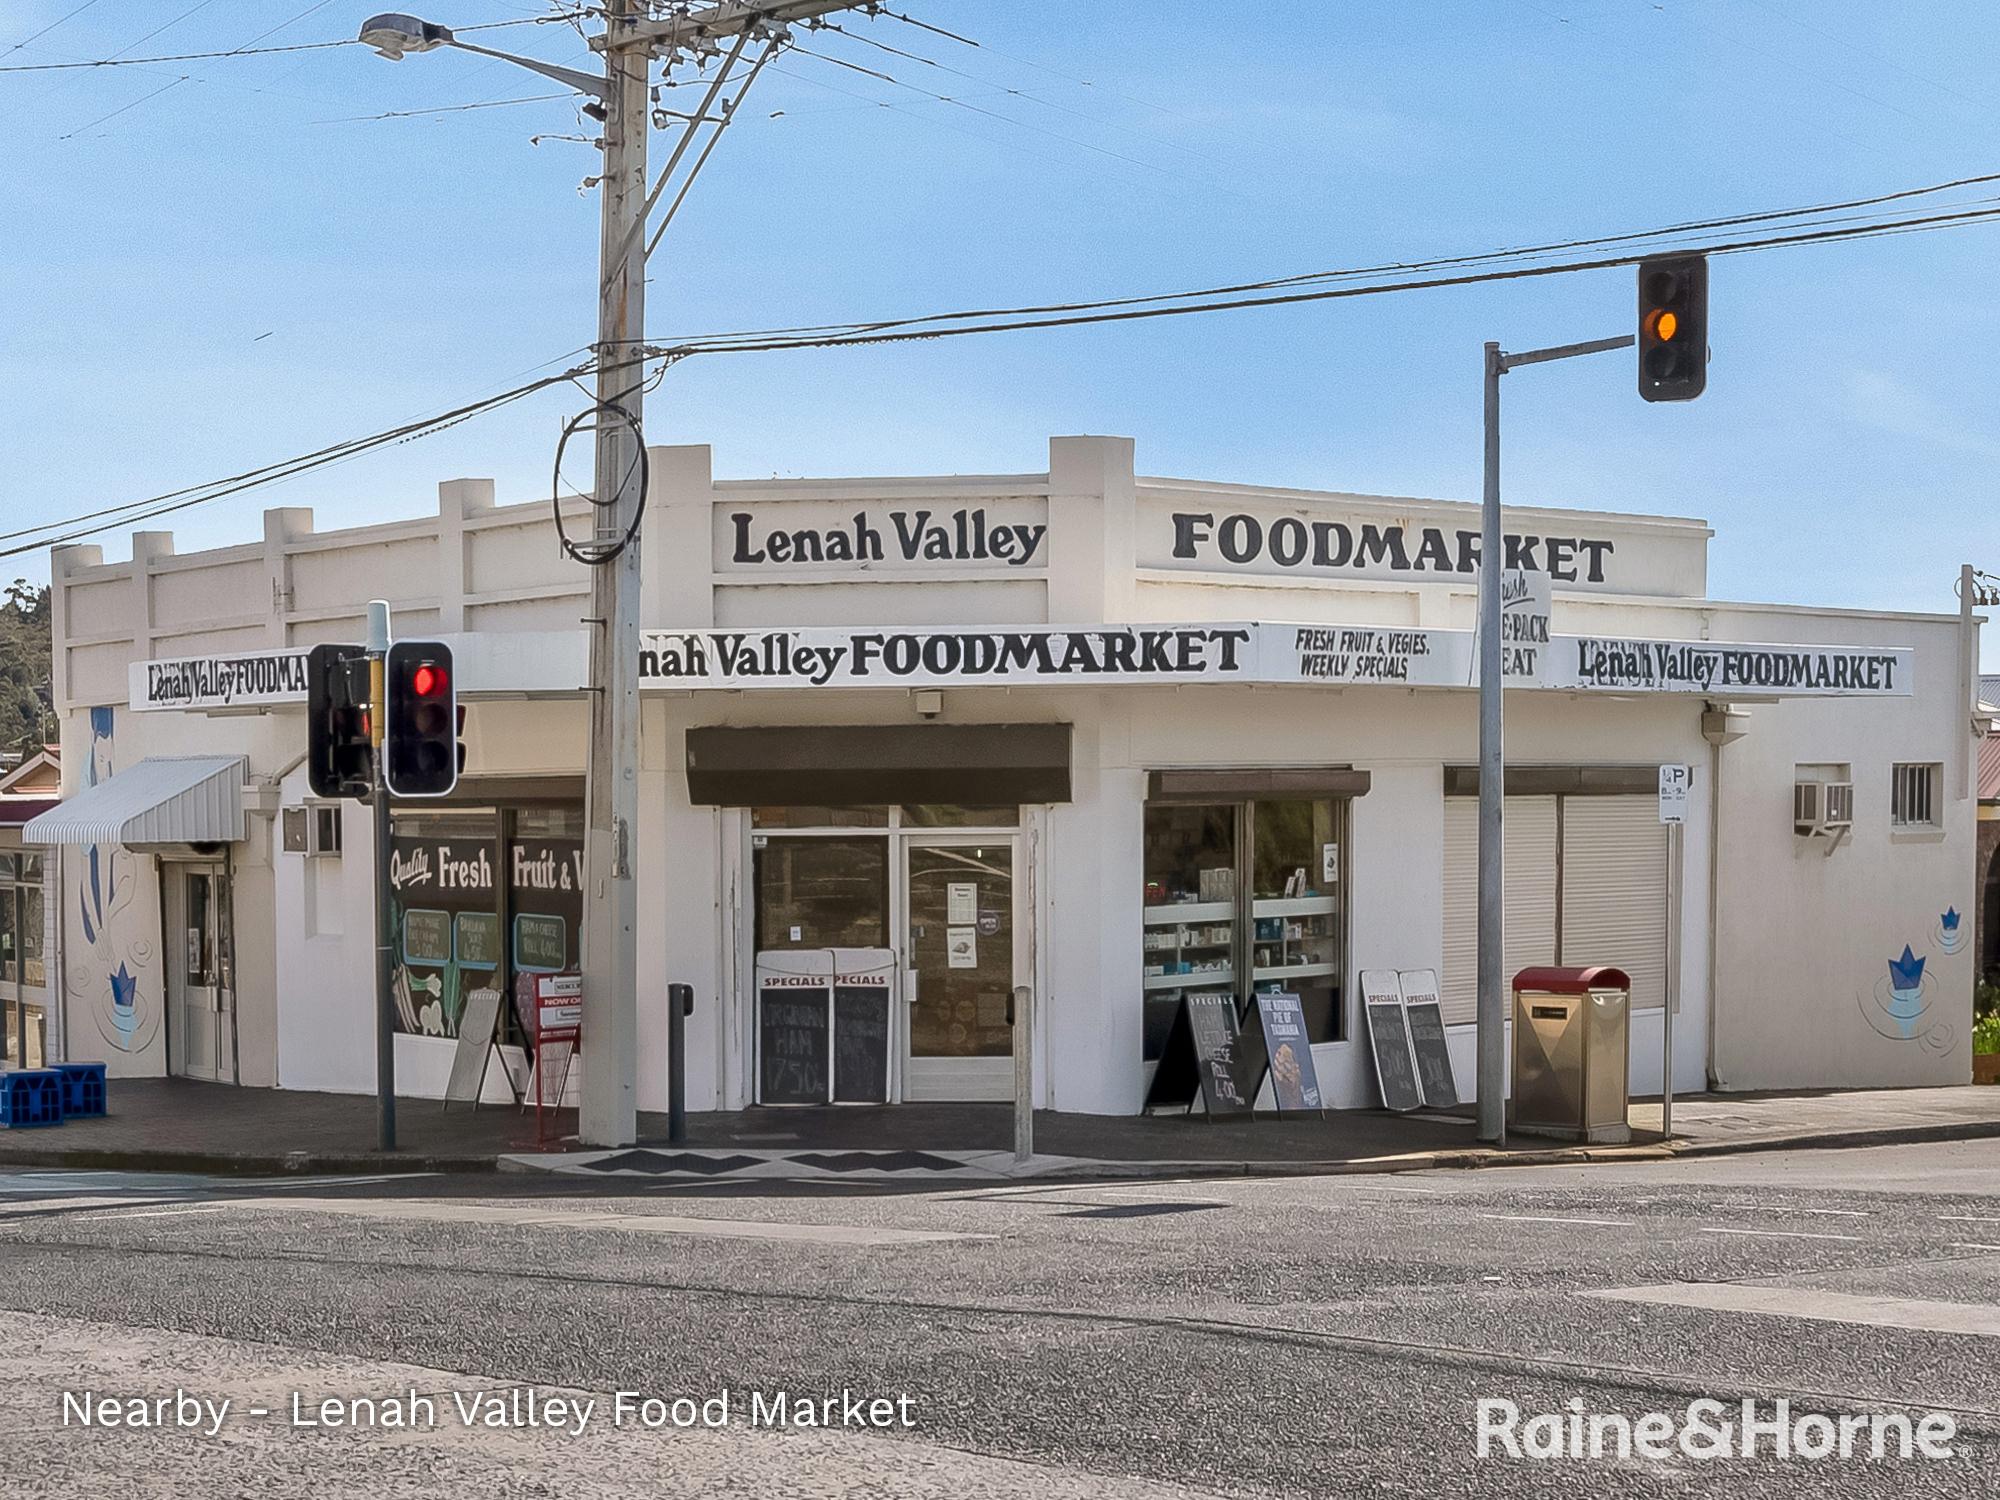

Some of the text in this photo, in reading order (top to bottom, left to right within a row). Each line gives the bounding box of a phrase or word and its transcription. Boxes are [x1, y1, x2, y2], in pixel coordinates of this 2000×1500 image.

[731, 509, 1047, 565] Lenah Valley
[1172, 513, 1614, 582] FOODMARKET
[706, 634, 847, 685] Valley
[850, 630, 1250, 676] FOODMARKET
[1295, 629, 1335, 652] FRESH
[1340, 631, 1374, 652] FRUIT
[1376, 637, 1385, 654] &
[148, 665, 192, 701] Lenah
[190, 660, 236, 704] Valley
[1300, 654, 1408, 680] WEEKLY SPECIALS
[1578, 640, 1898, 690] Lenah Valley FOODMARKET
[390, 848, 432, 890] Quality
[438, 846, 492, 888] Fresh
[513, 845, 557, 889] Fruit
[560, 862, 571, 890] &
[765, 977, 825, 987] SPECIALS
[1368, 994, 1398, 1003] SPECIALS
[1406, 993, 1436, 1004] SPECIALS
[544, 998, 569, 1006] NOW
